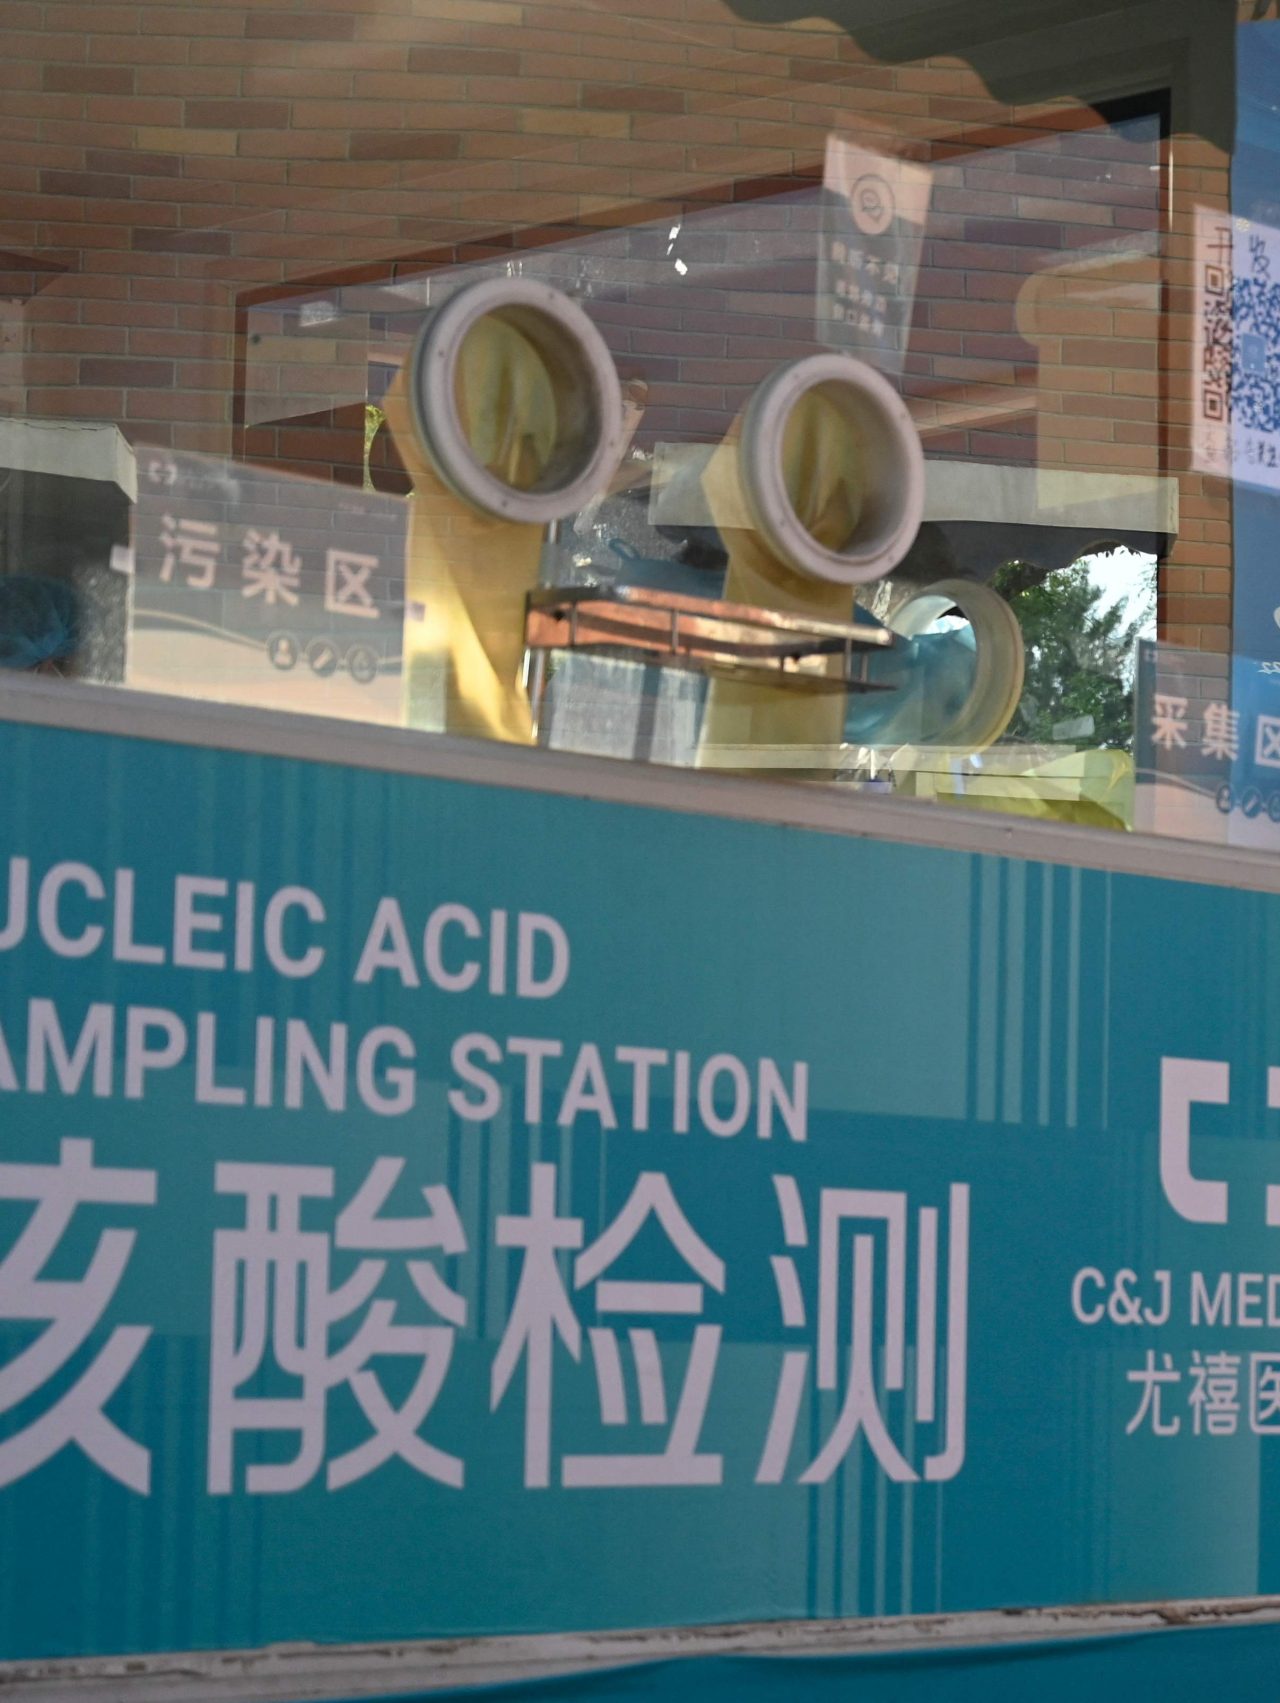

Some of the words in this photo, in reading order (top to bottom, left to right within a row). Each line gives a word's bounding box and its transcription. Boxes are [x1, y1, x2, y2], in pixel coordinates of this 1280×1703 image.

[159, 514, 381, 619] 污染区
[353, 897, 571, 999] ACID
[0, 996, 417, 1117] MPLING
[447, 1032, 809, 1143] STATION
[1071, 1266, 1172, 1326] C&J
